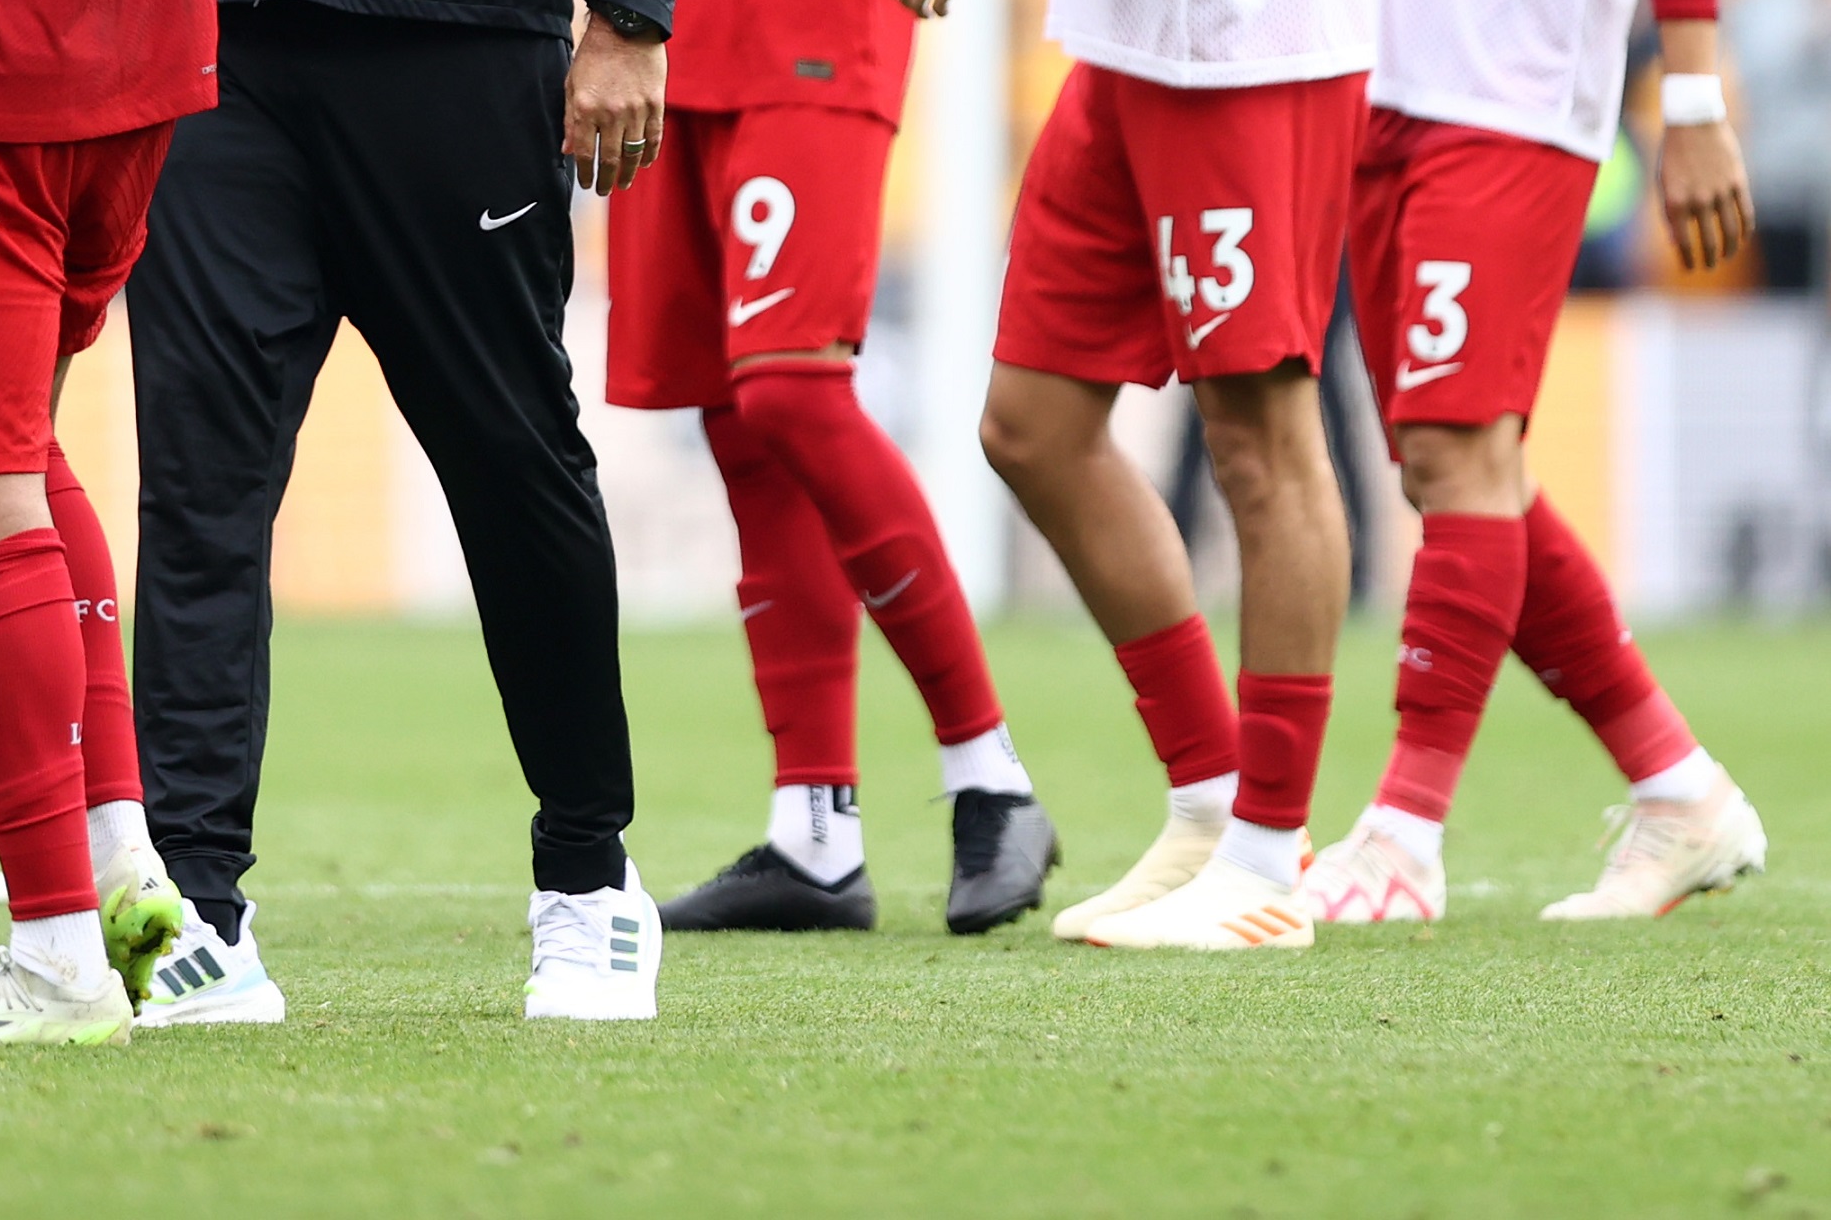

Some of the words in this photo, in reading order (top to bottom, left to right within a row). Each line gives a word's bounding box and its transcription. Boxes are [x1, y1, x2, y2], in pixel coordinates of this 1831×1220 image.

[731, 175, 797, 281] 9
[1157, 207, 1255, 316] 43
[1407, 260, 1473, 363] 3
